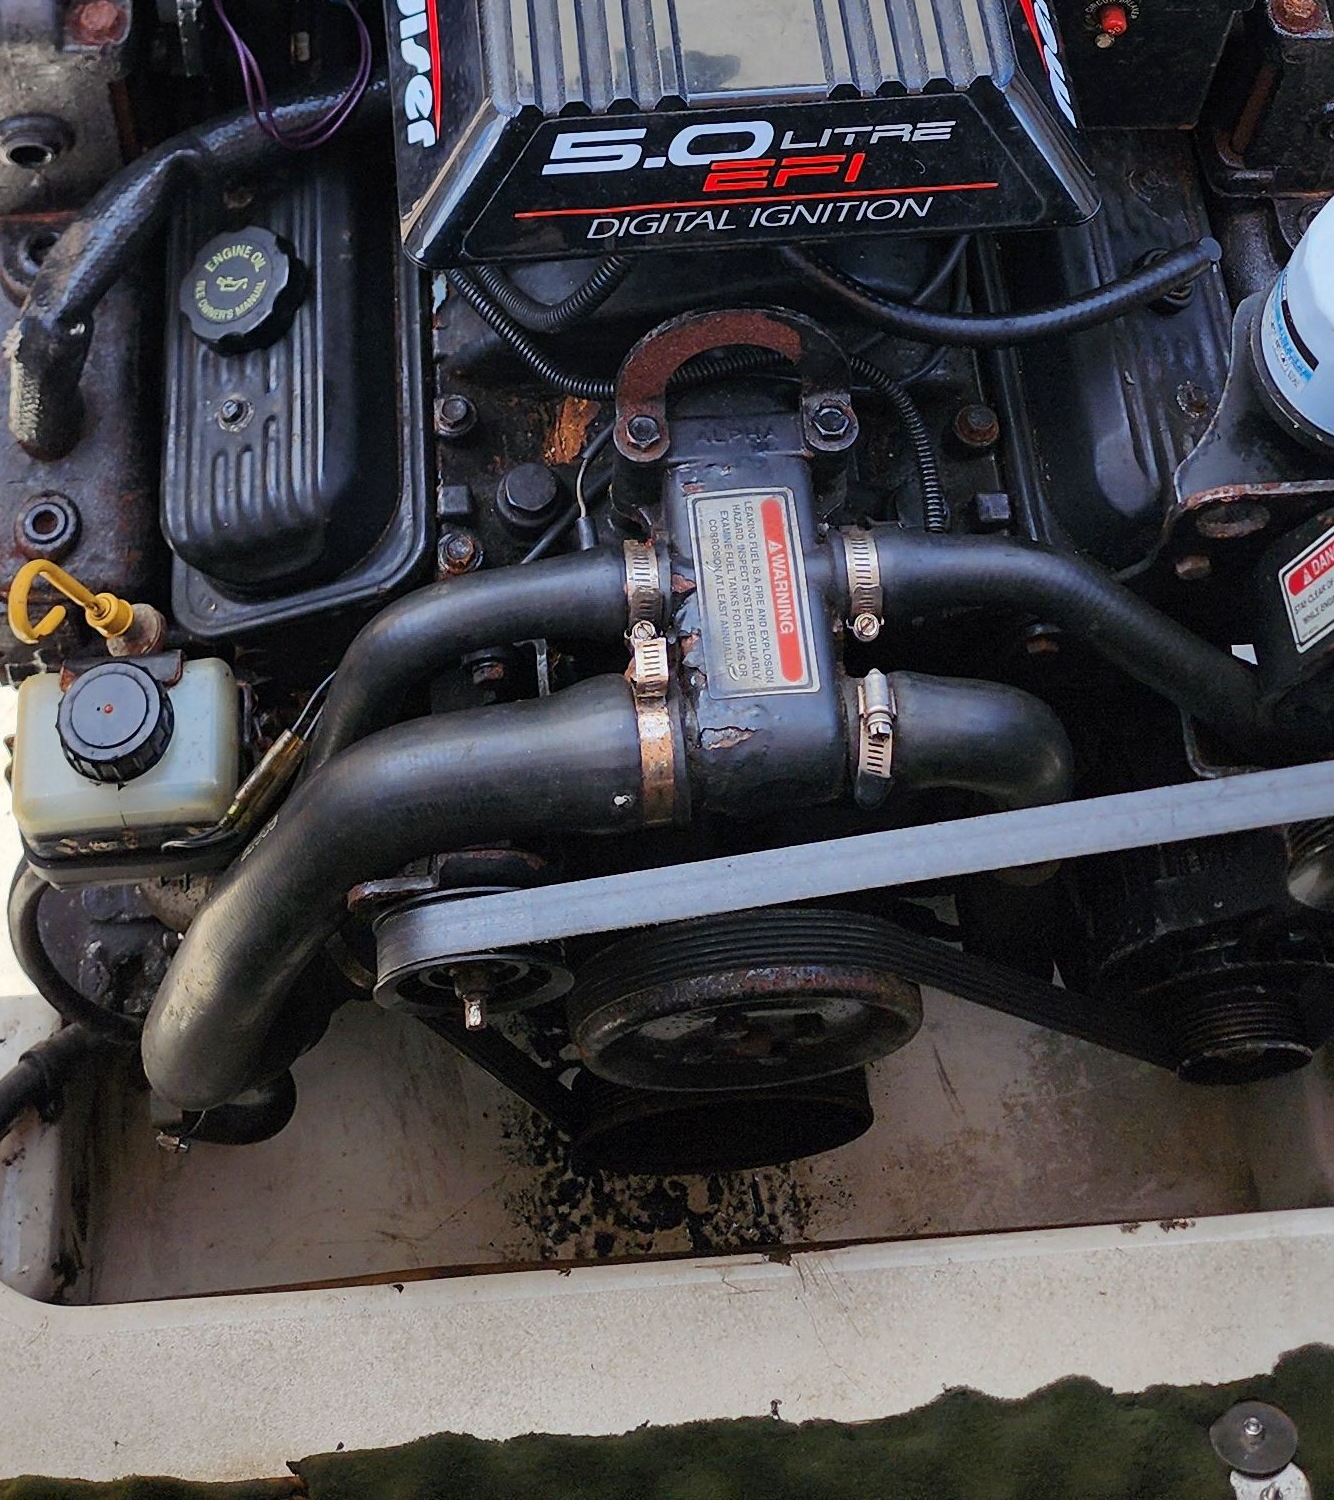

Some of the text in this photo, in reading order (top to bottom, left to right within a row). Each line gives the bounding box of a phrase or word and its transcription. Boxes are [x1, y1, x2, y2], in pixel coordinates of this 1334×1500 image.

[541, 120, 956, 176] 5.0 LITRE
[702, 152, 866, 192] EFI
[586, 196, 933, 239] DIGITAL IGNITION
[204, 245, 267, 273] ENGINE OIL
[235, 279, 267, 316] MANUAL
[744, 501, 756, 539] LEAKING
[709, 519, 722, 572] CORROSION
[737, 544, 750, 582] INSPECT
[749, 542, 760, 564] FUEL
[715, 574, 724, 586] AT
[753, 566, 761, 575] IS
[717, 588, 728, 617] LEAST
[720, 510, 747, 677] EXAMINE FUEL TANKS FOR LEAKS OR
[742, 585, 753, 622] SYSTEM
[755, 585, 765, 605] FIRE
[771, 553, 794, 634] WARNING
[1294, 601, 1307, 615] STAY
[1308, 584, 1326, 600] CLEAR
[1326, 578, 1334, 589] OF
[758, 608, 767, 627] AND
[1303, 610, 1320, 625] WHILE
[760, 630, 775, 683] EXPLOSION
